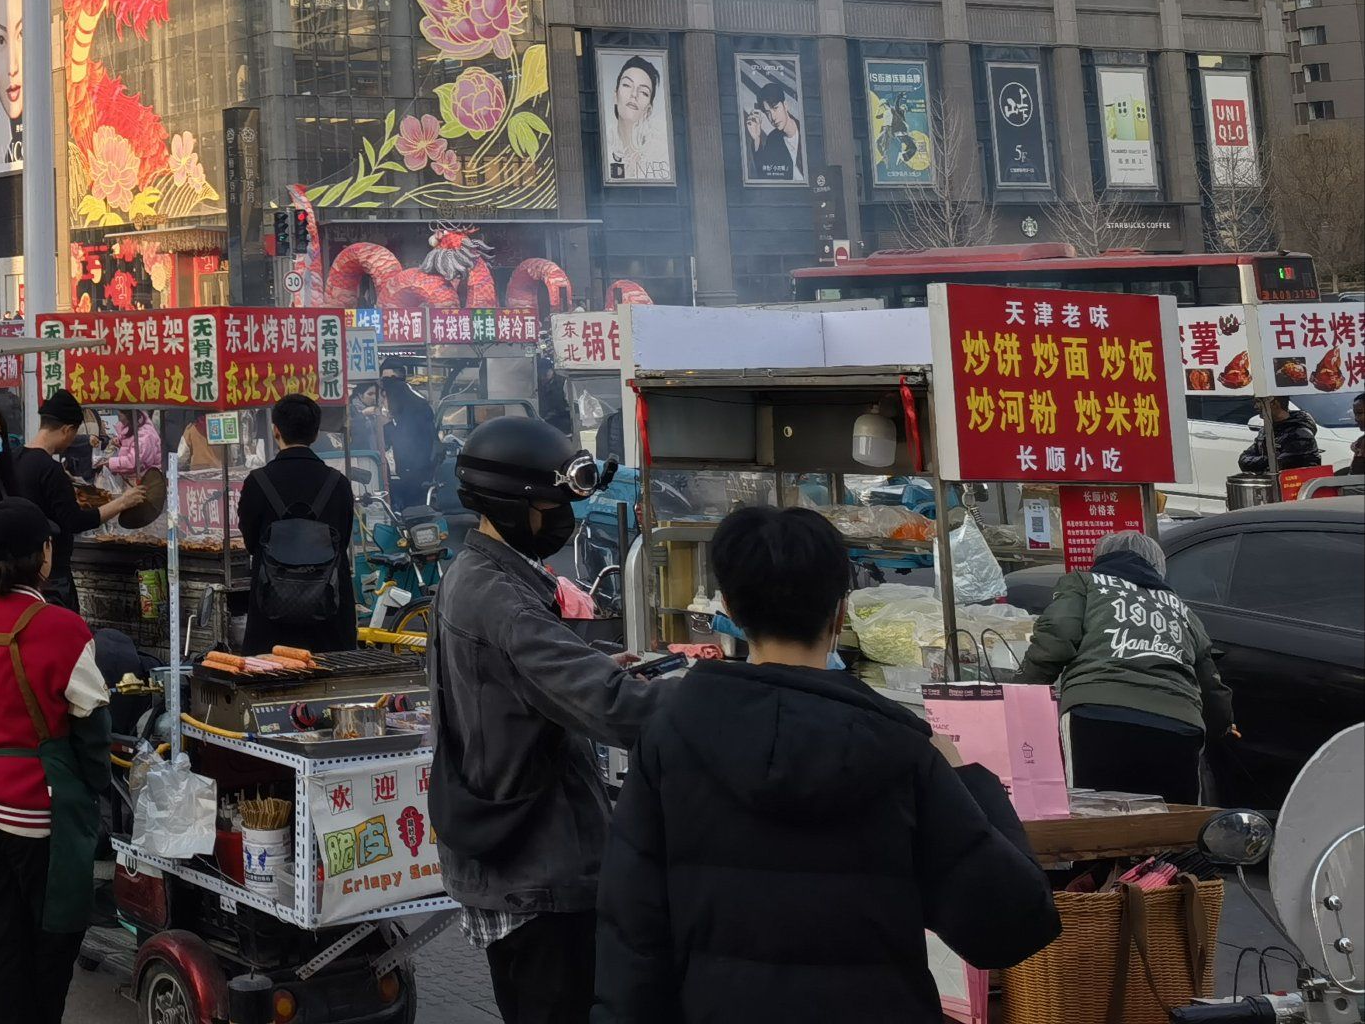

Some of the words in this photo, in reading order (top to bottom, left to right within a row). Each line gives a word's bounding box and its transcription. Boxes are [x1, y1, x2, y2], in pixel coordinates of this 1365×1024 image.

[1215, 105, 1241, 122] UNI
[1218, 124, 1245, 143] QLO
[287, 277, 300, 287] 30
[387, 309, 423, 341] 烤冷面
[432, 315, 471, 341] 布袋馍
[473, 315, 496, 341] 炸串
[497, 315, 537, 340] 烤冷面
[1004, 300, 1110, 330] 天津老味
[1269, 311, 1365, 350] 古法烤
[68, 315, 185, 357] 东北烤鸡架
[224, 313, 316, 353] 东北烤鸡架
[562, 320, 582, 362] 东北
[192, 317, 215, 402] 无骨鸡爪
[320, 318, 340, 398] 无骨鸡爪
[349, 338, 377, 372] 冷面
[961, 330, 1023, 378] 炒饼
[1031, 334, 1090, 380] 炒面
[1098, 336, 1157, 382] 炒饭
[68, 362, 189, 404] 东北大油边
[224, 360, 320, 405] 东北大油边
[966, 386, 1058, 435] 炒河粉
[1073, 390, 1160, 437] 炒米粉
[1016, 444, 1123, 473] 长顺小吃
[1083, 490, 1119, 503] 长顺小吃
[1088, 504, 1116, 517] 价格表
[1092, 573, 1138, 592] NEW
[1147, 588, 1191, 623] YORK
[1104, 627, 1184, 659] Yankees
[341, 870, 403, 895] Crispy
[409, 861, 441, 880] Sau
